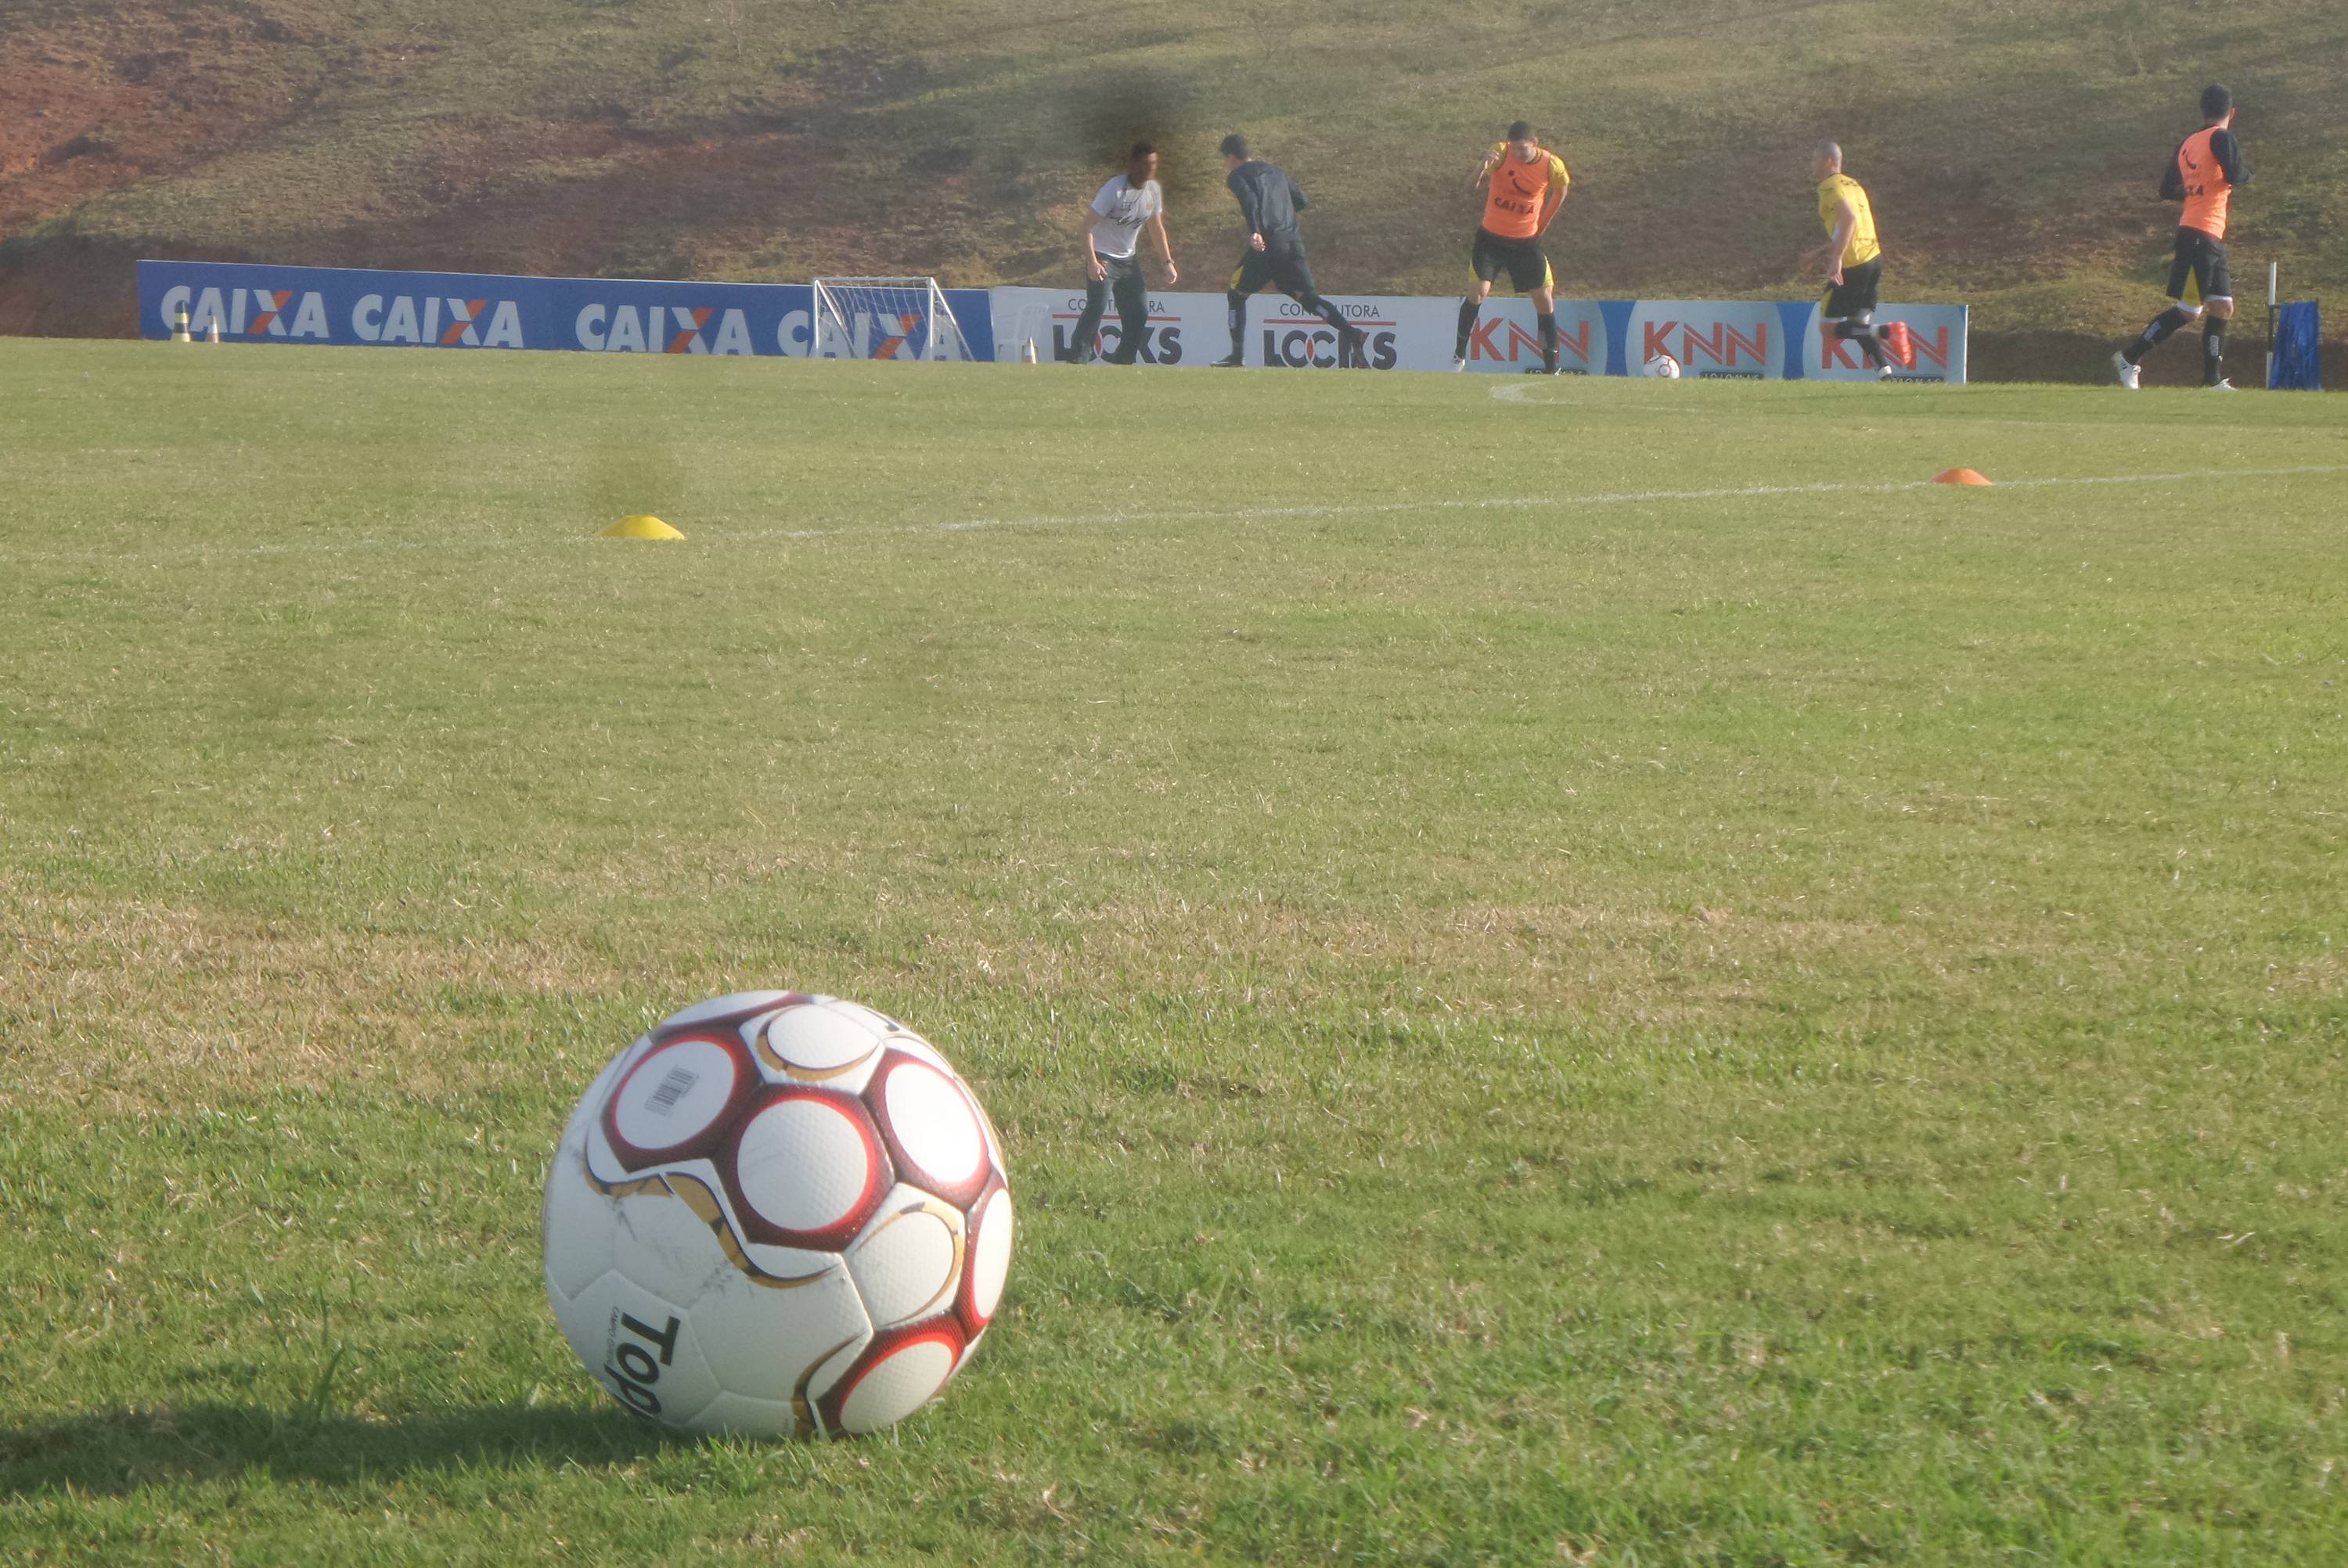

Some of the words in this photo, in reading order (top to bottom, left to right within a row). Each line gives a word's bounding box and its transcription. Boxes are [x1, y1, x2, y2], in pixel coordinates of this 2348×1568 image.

[160, 286, 330, 338] CAIXA
[351, 294, 524, 347] CAIXA
[575, 303, 754, 355] CAIXA
[777, 310, 962, 361] CAIXA
[1053, 325, 1183, 365] LCKS
[1263, 329, 1397, 370] LOCKS
[1471, 317, 1590, 364] KNN
[1644, 322, 1766, 366] KNN
